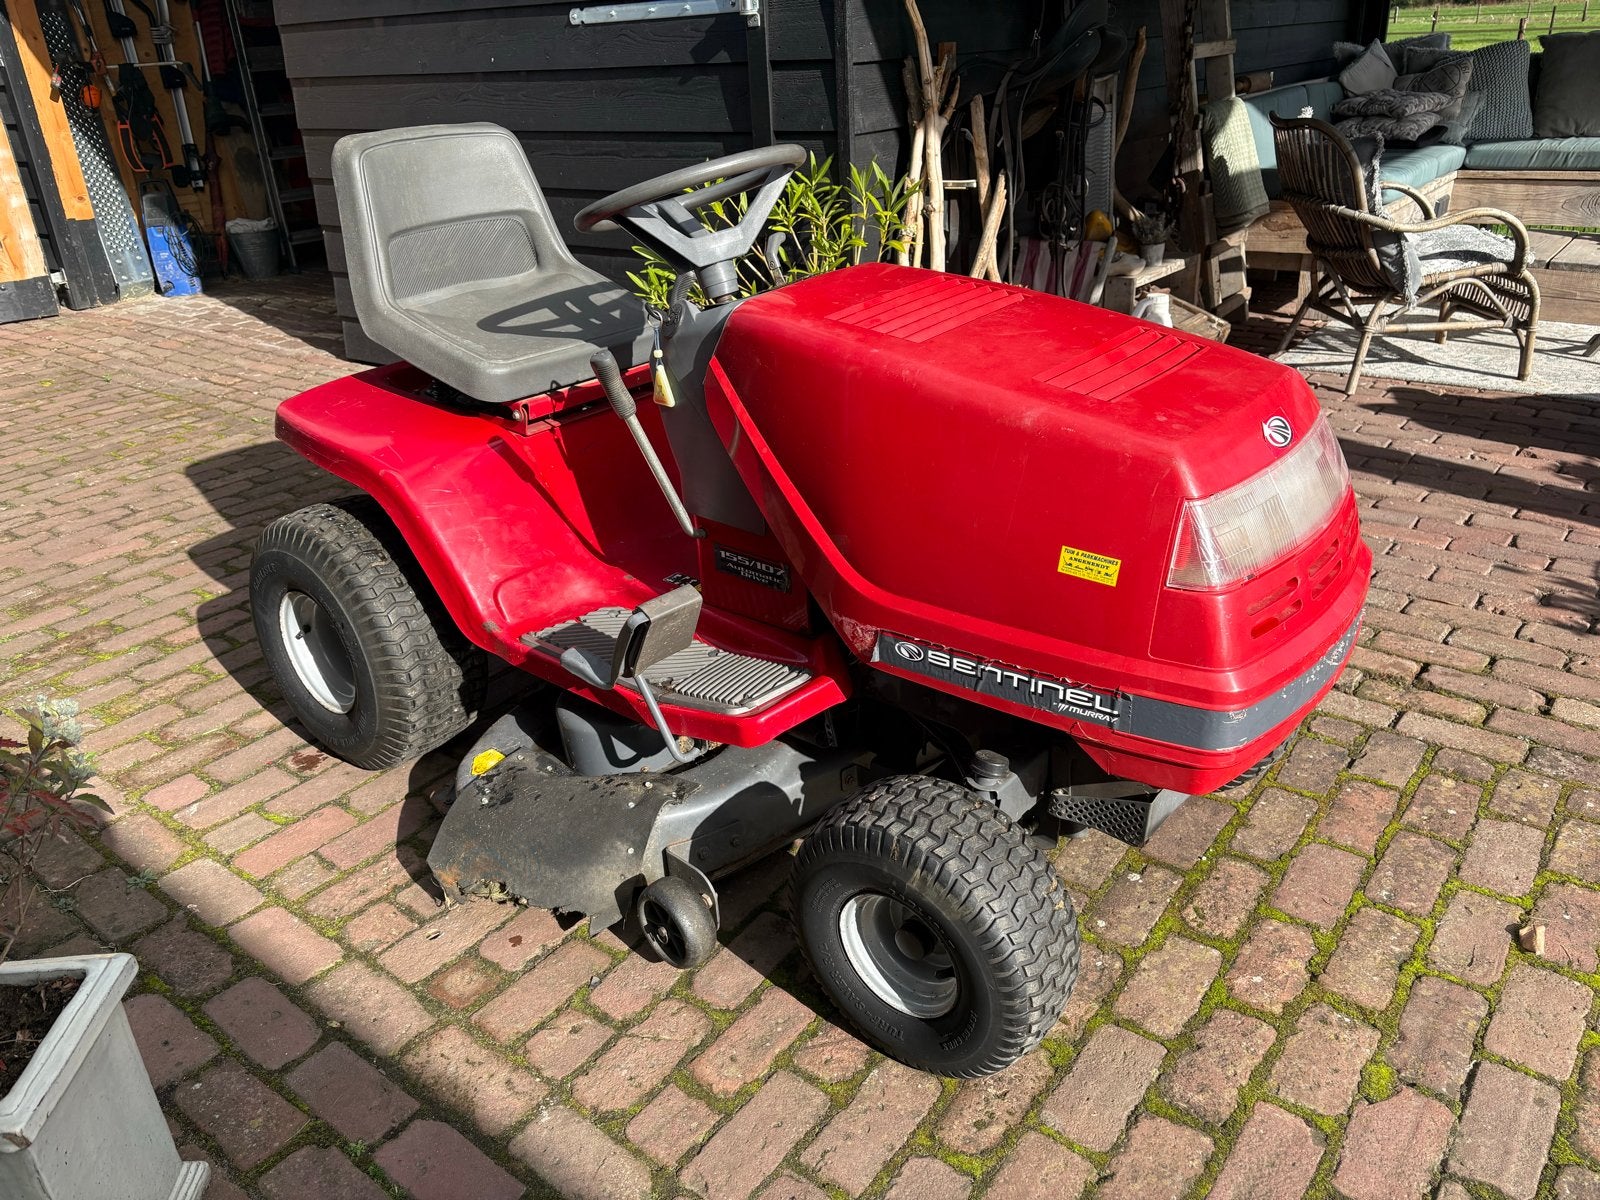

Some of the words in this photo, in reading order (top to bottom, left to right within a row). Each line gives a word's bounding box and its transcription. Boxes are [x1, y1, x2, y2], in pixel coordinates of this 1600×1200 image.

[719, 550, 785, 576] 155/107
[726, 562, 785, 584] Automatic
[740, 571, 769, 584] Drive
[1068, 705, 1119, 723] MURRAY
